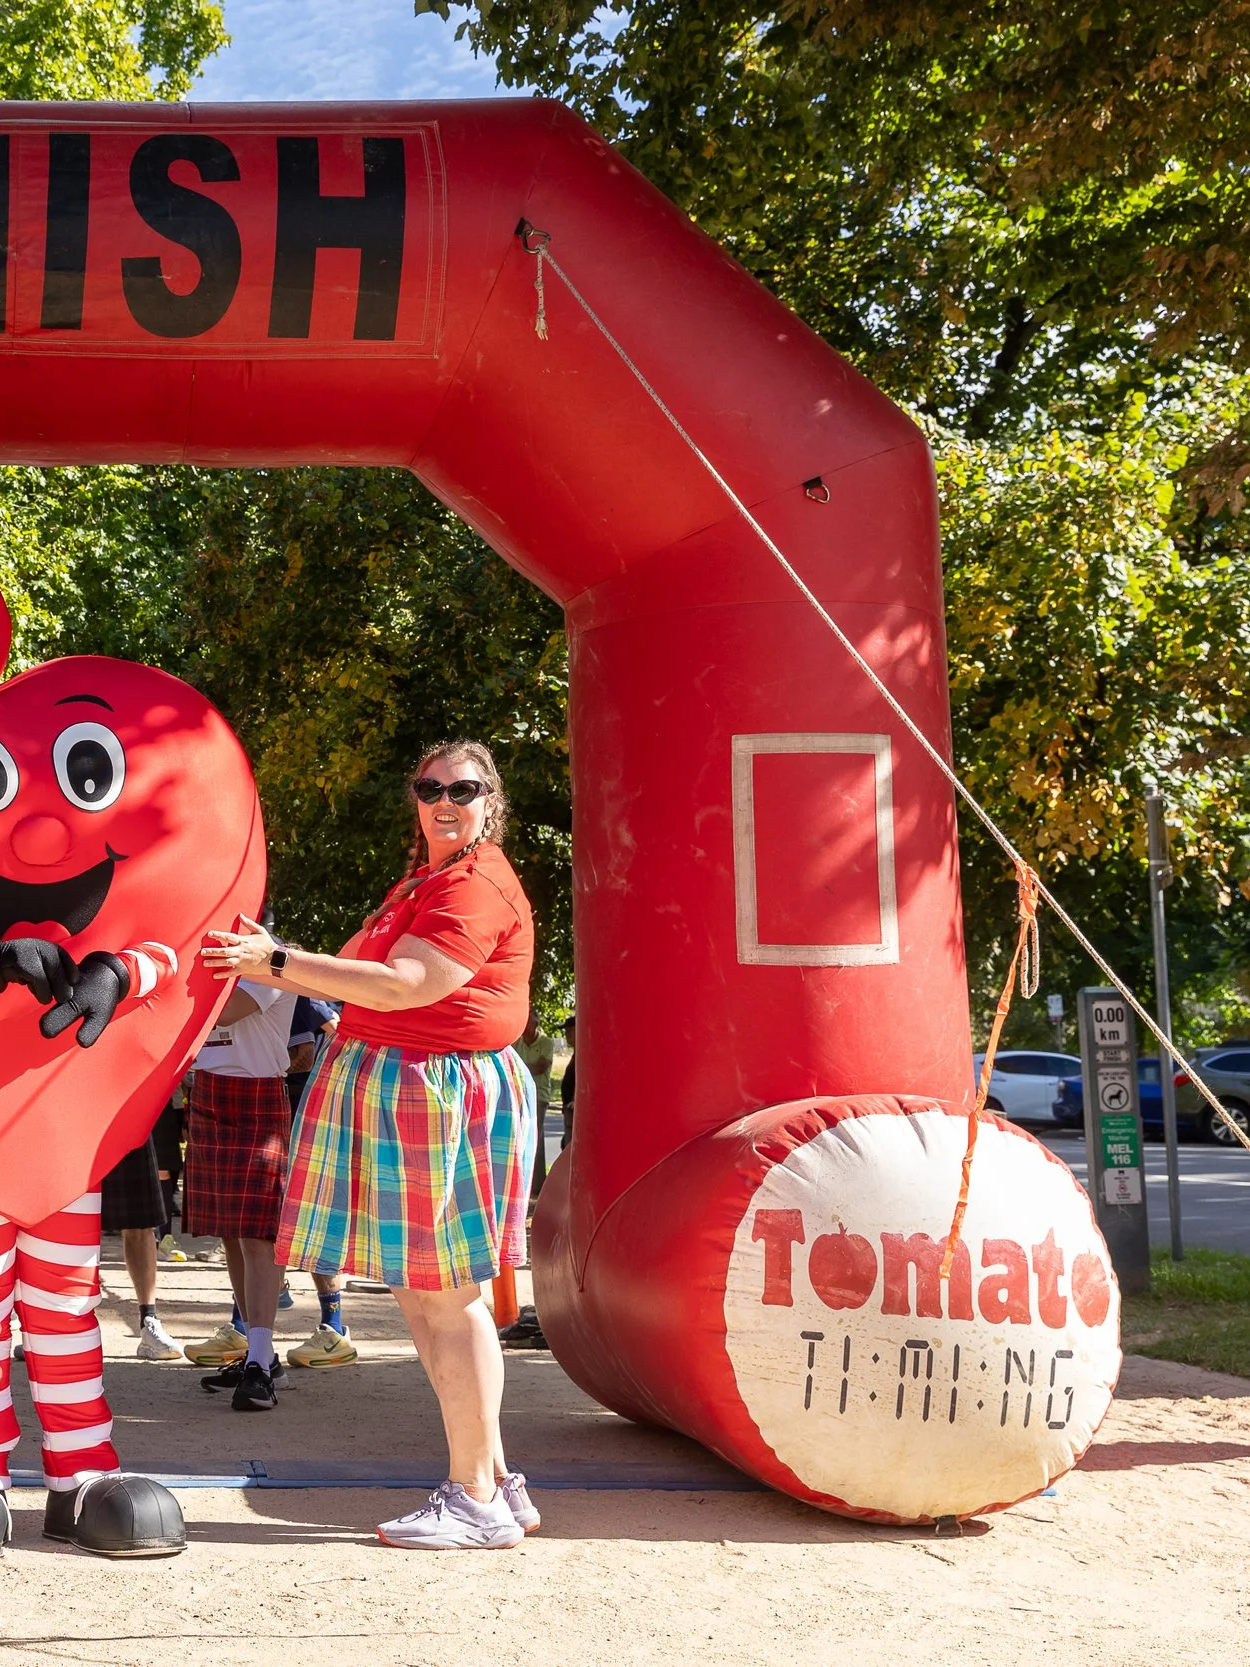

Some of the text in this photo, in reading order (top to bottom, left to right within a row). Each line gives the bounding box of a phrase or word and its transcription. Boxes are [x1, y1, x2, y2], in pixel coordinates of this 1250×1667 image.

[1095, 1008, 1124, 1023] 0.00
[1100, 1028, 1120, 1040] km
[1107, 1144, 1134, 1154] MEL
[1111, 1155, 1131, 1165] 116
[751, 1209, 1110, 1329] Tomato
